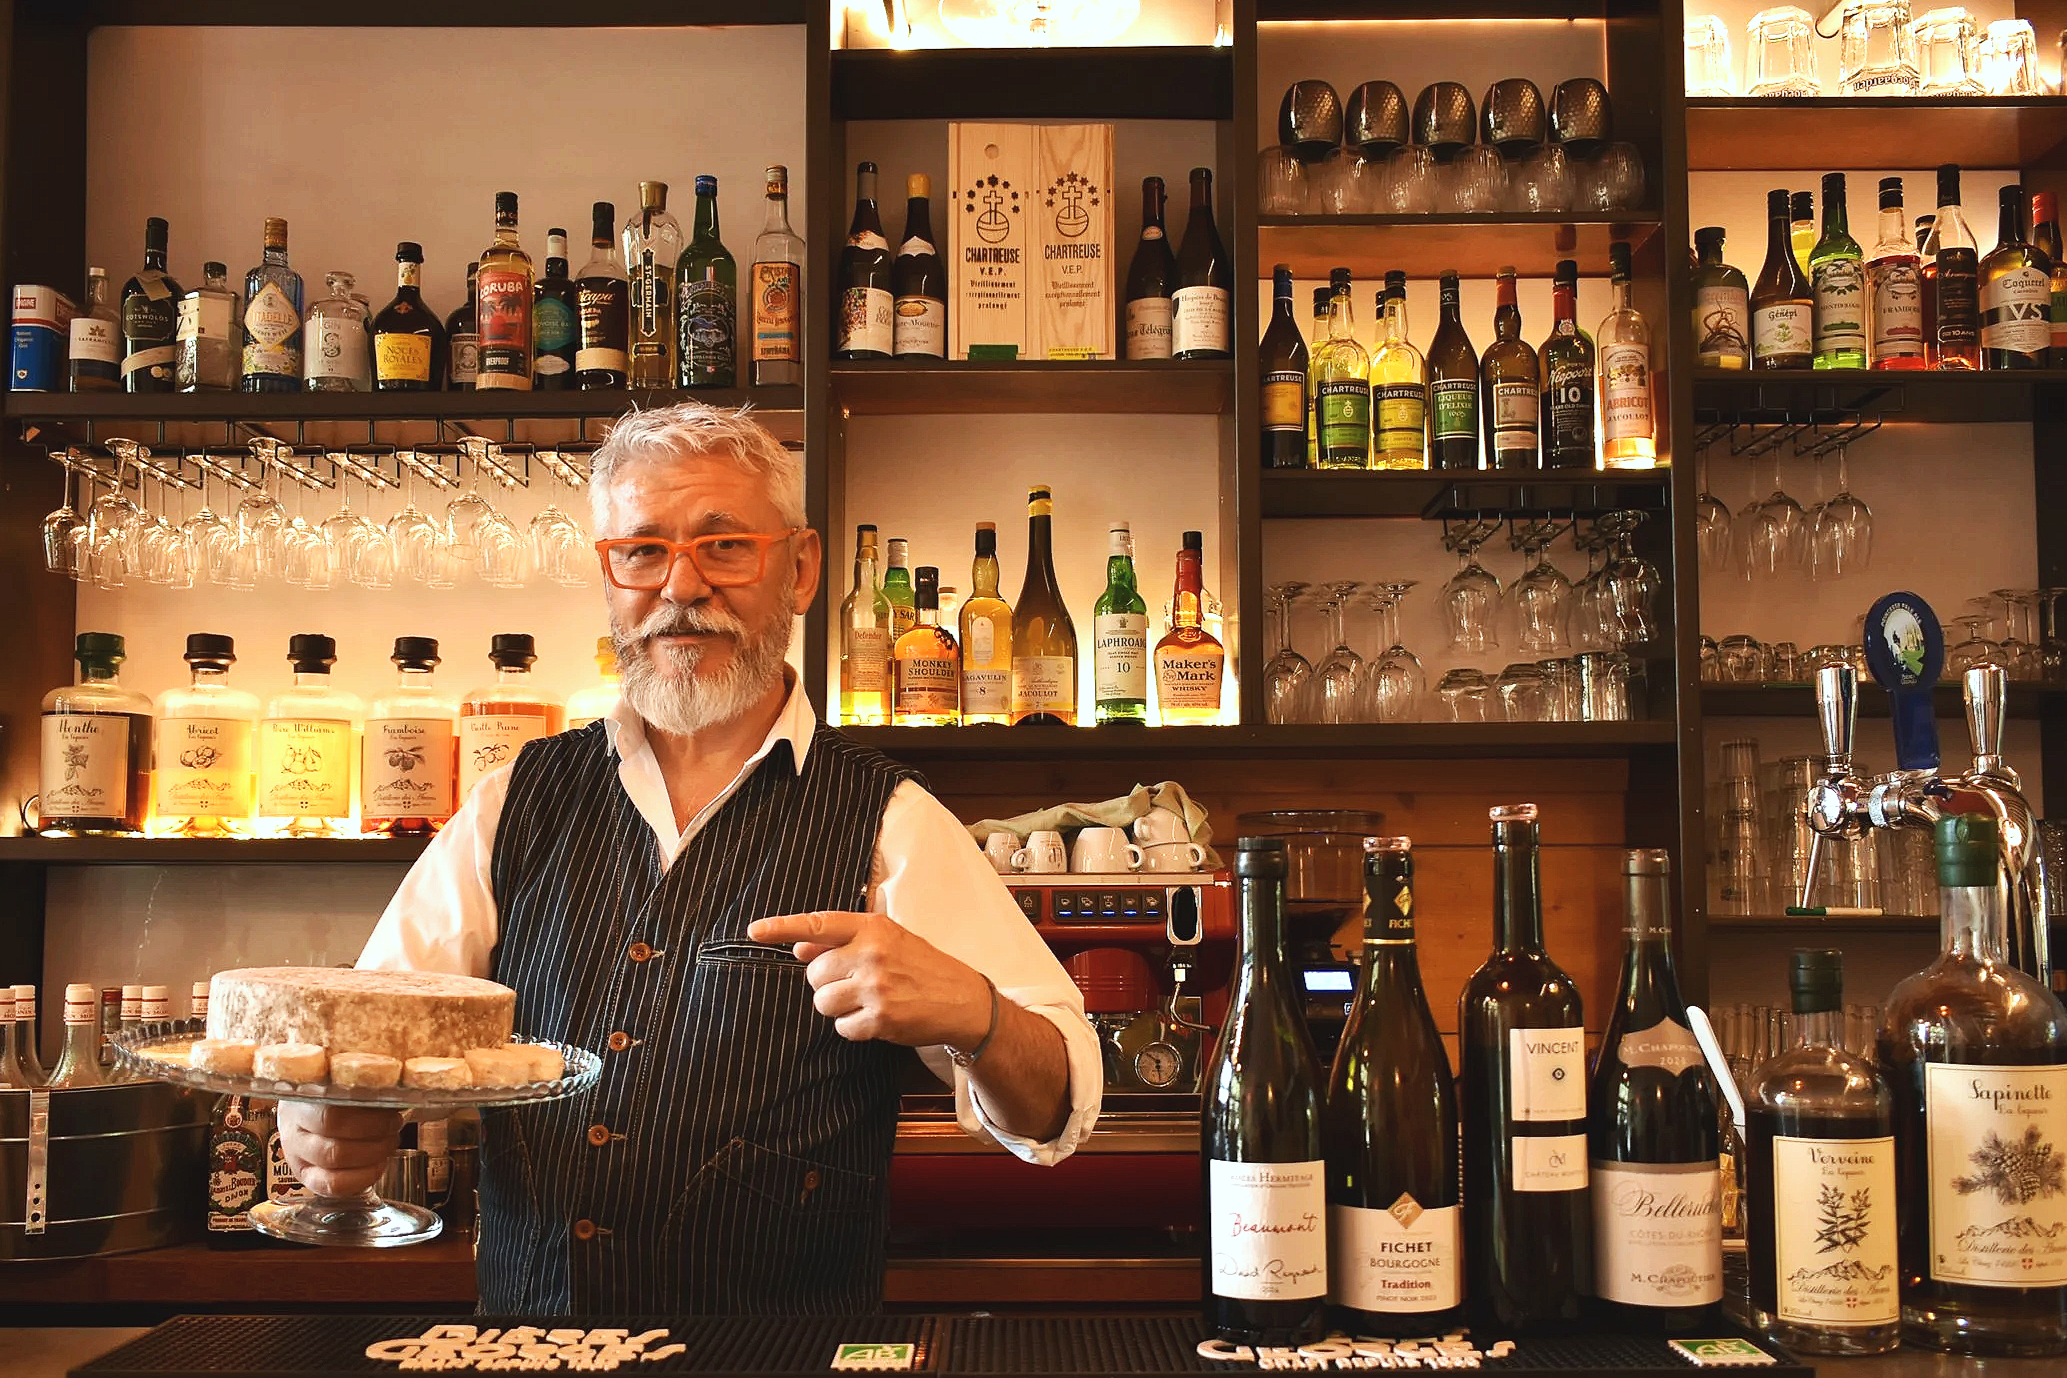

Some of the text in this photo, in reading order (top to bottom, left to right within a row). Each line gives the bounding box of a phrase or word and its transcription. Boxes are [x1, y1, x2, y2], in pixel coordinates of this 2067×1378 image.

[966, 247, 1020, 264] CHARTREUSE
[1044, 243, 1100, 260] CHARTREUSE
[980, 267, 1007, 276] V.E.P.
[1062, 265, 1083, 275] V.E.P.
[1768, 308, 1798, 321] Génépi
[2008, 301, 2043, 321] VS
[1264, 373, 1303, 383] ARTREUSE
[1560, 386, 1581, 404] 10
[900, 611, 915, 621] SAR
[912, 659, 953, 669] MONKEY
[1116, 662, 1131, 673] 10
[1163, 659, 1217, 669] Maker's
[1177, 671, 1216, 681] Mark
[1388, 918, 1414, 929] FICHE
[1526, 1041, 1580, 1054] VINCENT
[1968, 1078, 2053, 1111] Sapinette
[273, 1162, 292, 1175] MÛ
[224, 1189, 249, 1203] DIJON
[1228, 1212, 1319, 1238] Beaumont
[1380, 1241, 1433, 1253] FICHET
[1369, 1257, 1441, 1269] BOURGOGNE
[1381, 1279, 1431, 1289] Tradition
